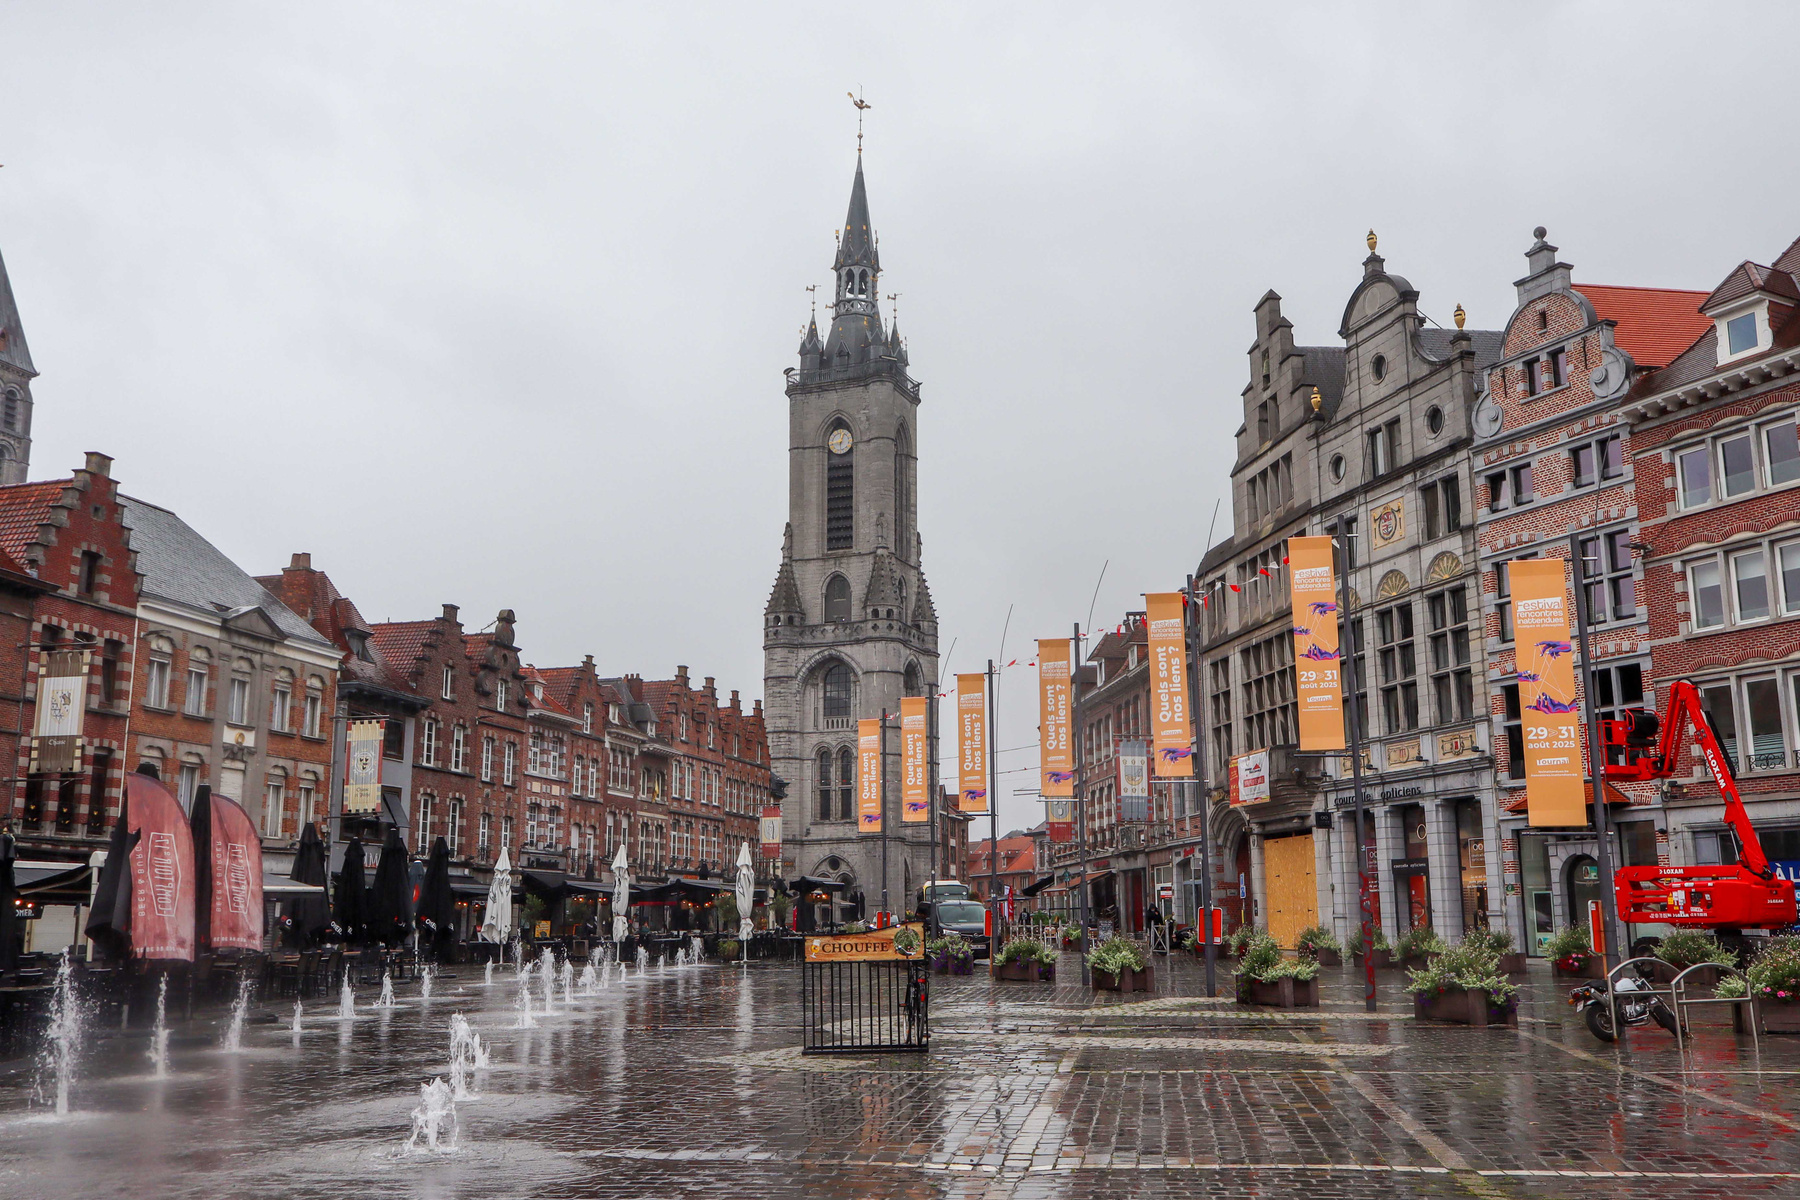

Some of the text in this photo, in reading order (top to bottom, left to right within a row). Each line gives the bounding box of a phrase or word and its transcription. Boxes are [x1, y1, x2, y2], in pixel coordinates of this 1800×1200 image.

[1294, 568, 1330, 578] Festival
[1515, 598, 1563, 610] Festival
[1517, 610, 1563, 618] rencontres
[1156, 646, 1171, 722] Quels sont
[1168, 646, 1183, 722] nos liens ?
[1046, 684, 1055, 711] sont
[1056, 695, 1066, 723] liens
[972, 722, 981, 748] liens
[1047, 714, 1057, 749] Quels
[914, 742, 922, 765] liens
[963, 740, 973, 770] Quels
[869, 760, 877, 781] liens
[907, 758, 915, 785] Quels
[1707, 753, 1726, 789] LOXAM
[862, 774, 870, 799] Quels
[1334, 792, 1371, 806] courclle
[1789, 867, 1800, 882] L
[822, 942, 889, 953] CHOUFFE
